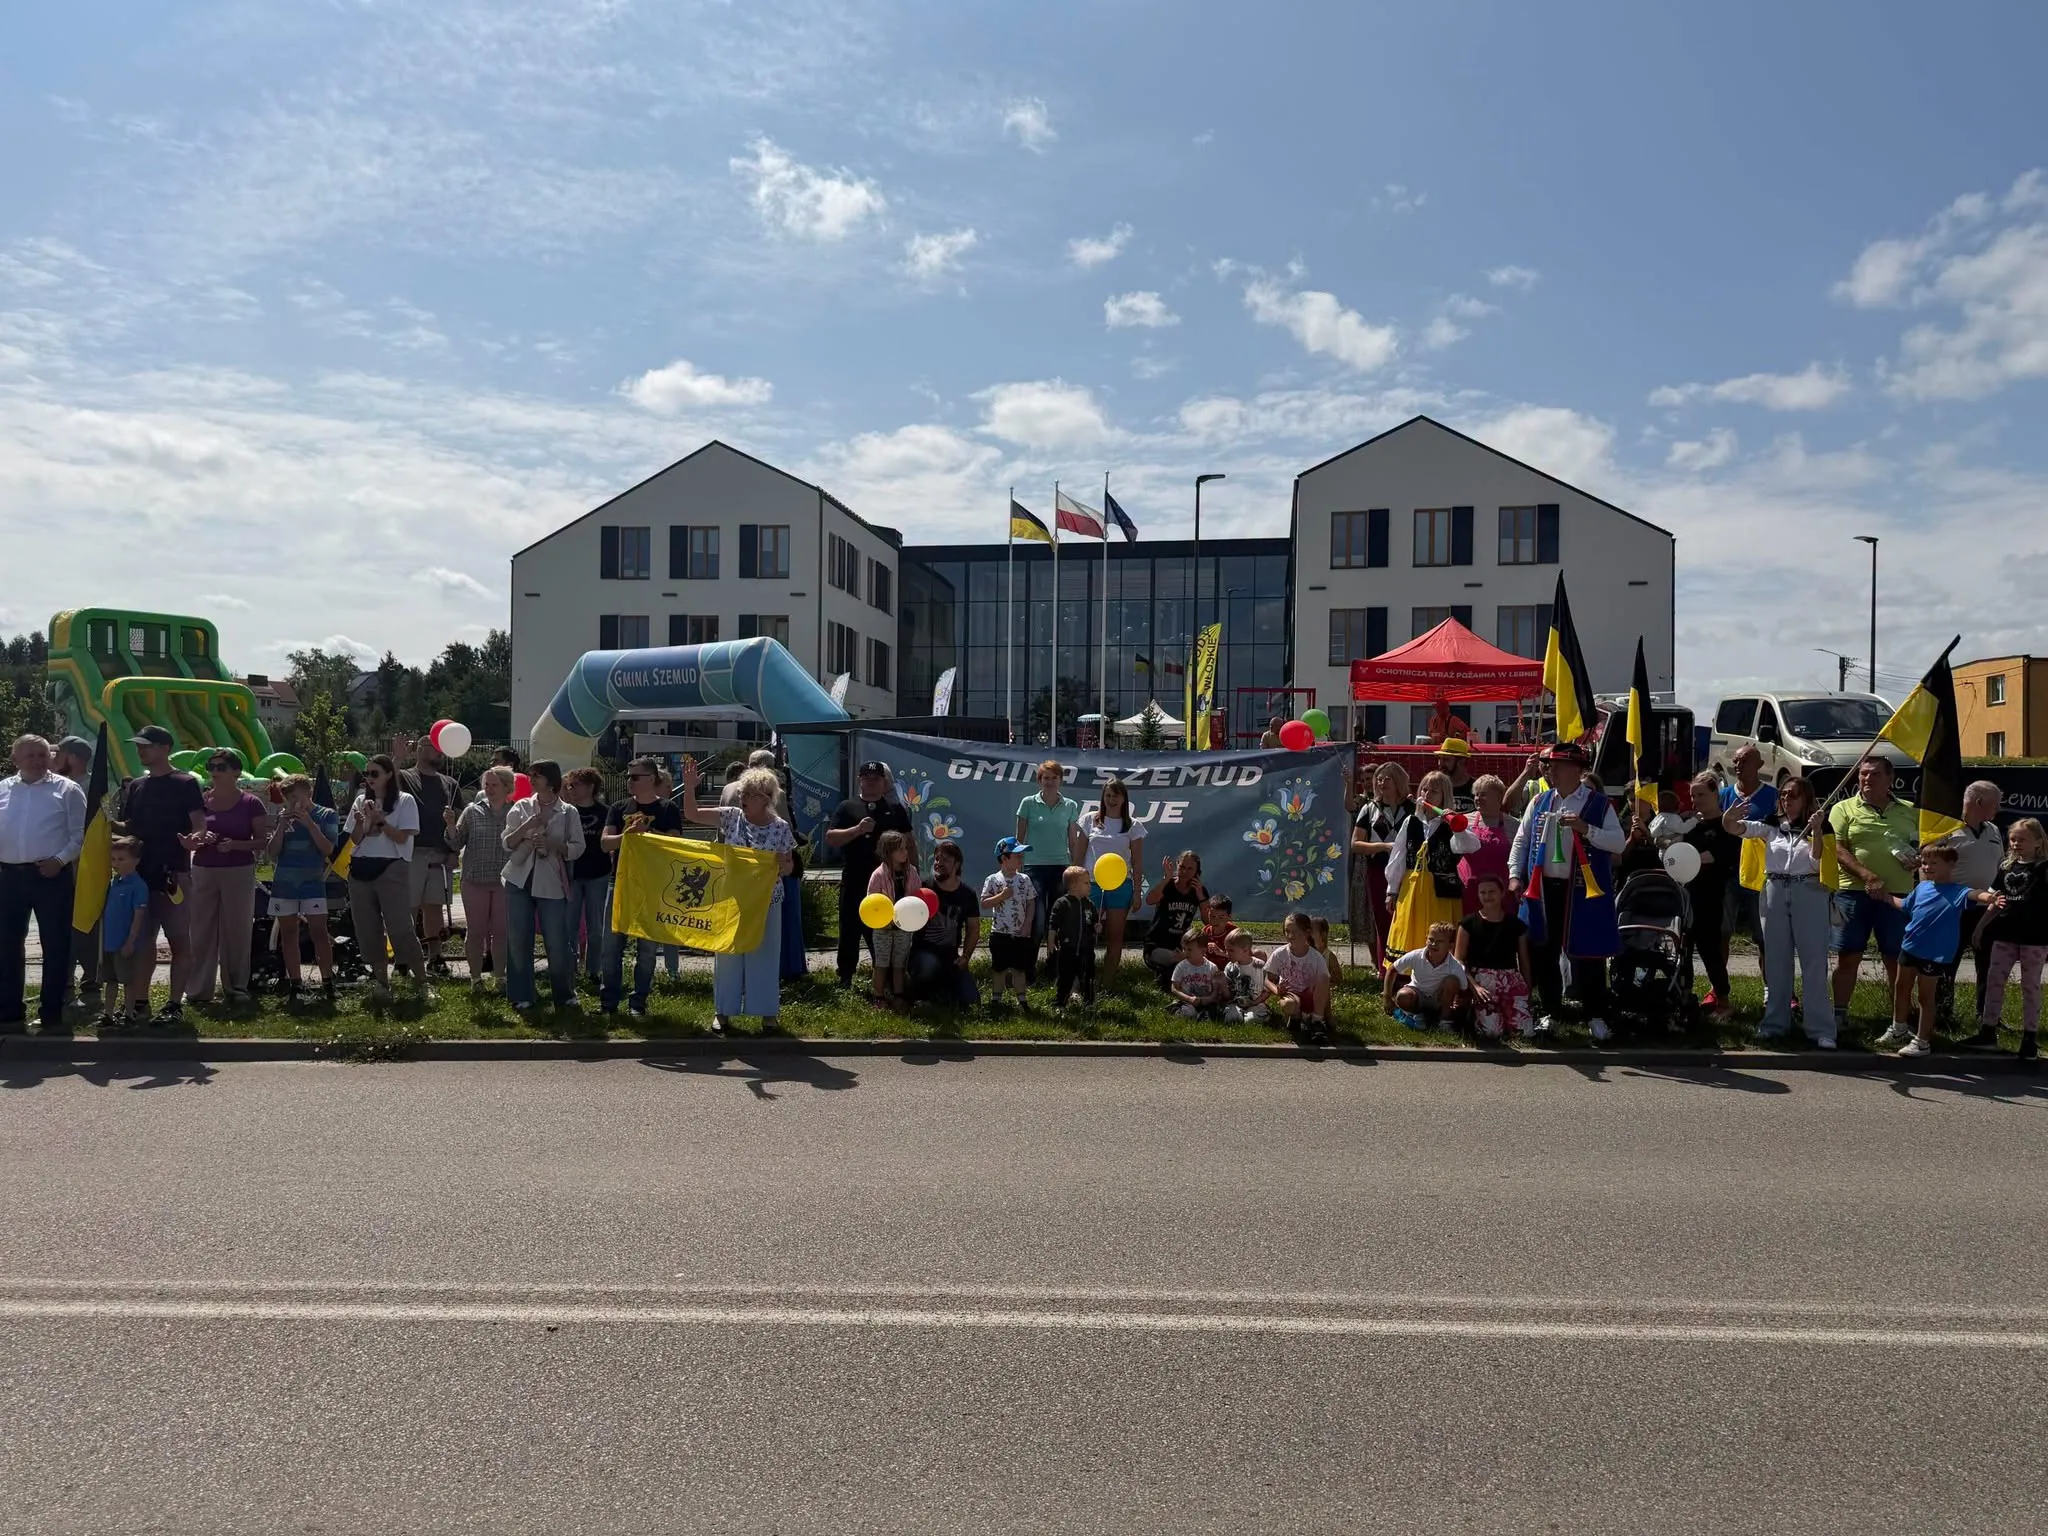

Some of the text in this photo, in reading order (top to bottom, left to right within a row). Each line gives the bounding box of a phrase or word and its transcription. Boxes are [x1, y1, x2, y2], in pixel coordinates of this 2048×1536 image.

[1203, 638, 1217, 691] WŁOSKIE
[1376, 668, 1427, 677] OCHOTNICZA
[1456, 671, 1496, 679] POŻARNA
[614, 667, 697, 688] GMINA SZEMUD
[1092, 766, 1264, 787] SZEMUD
